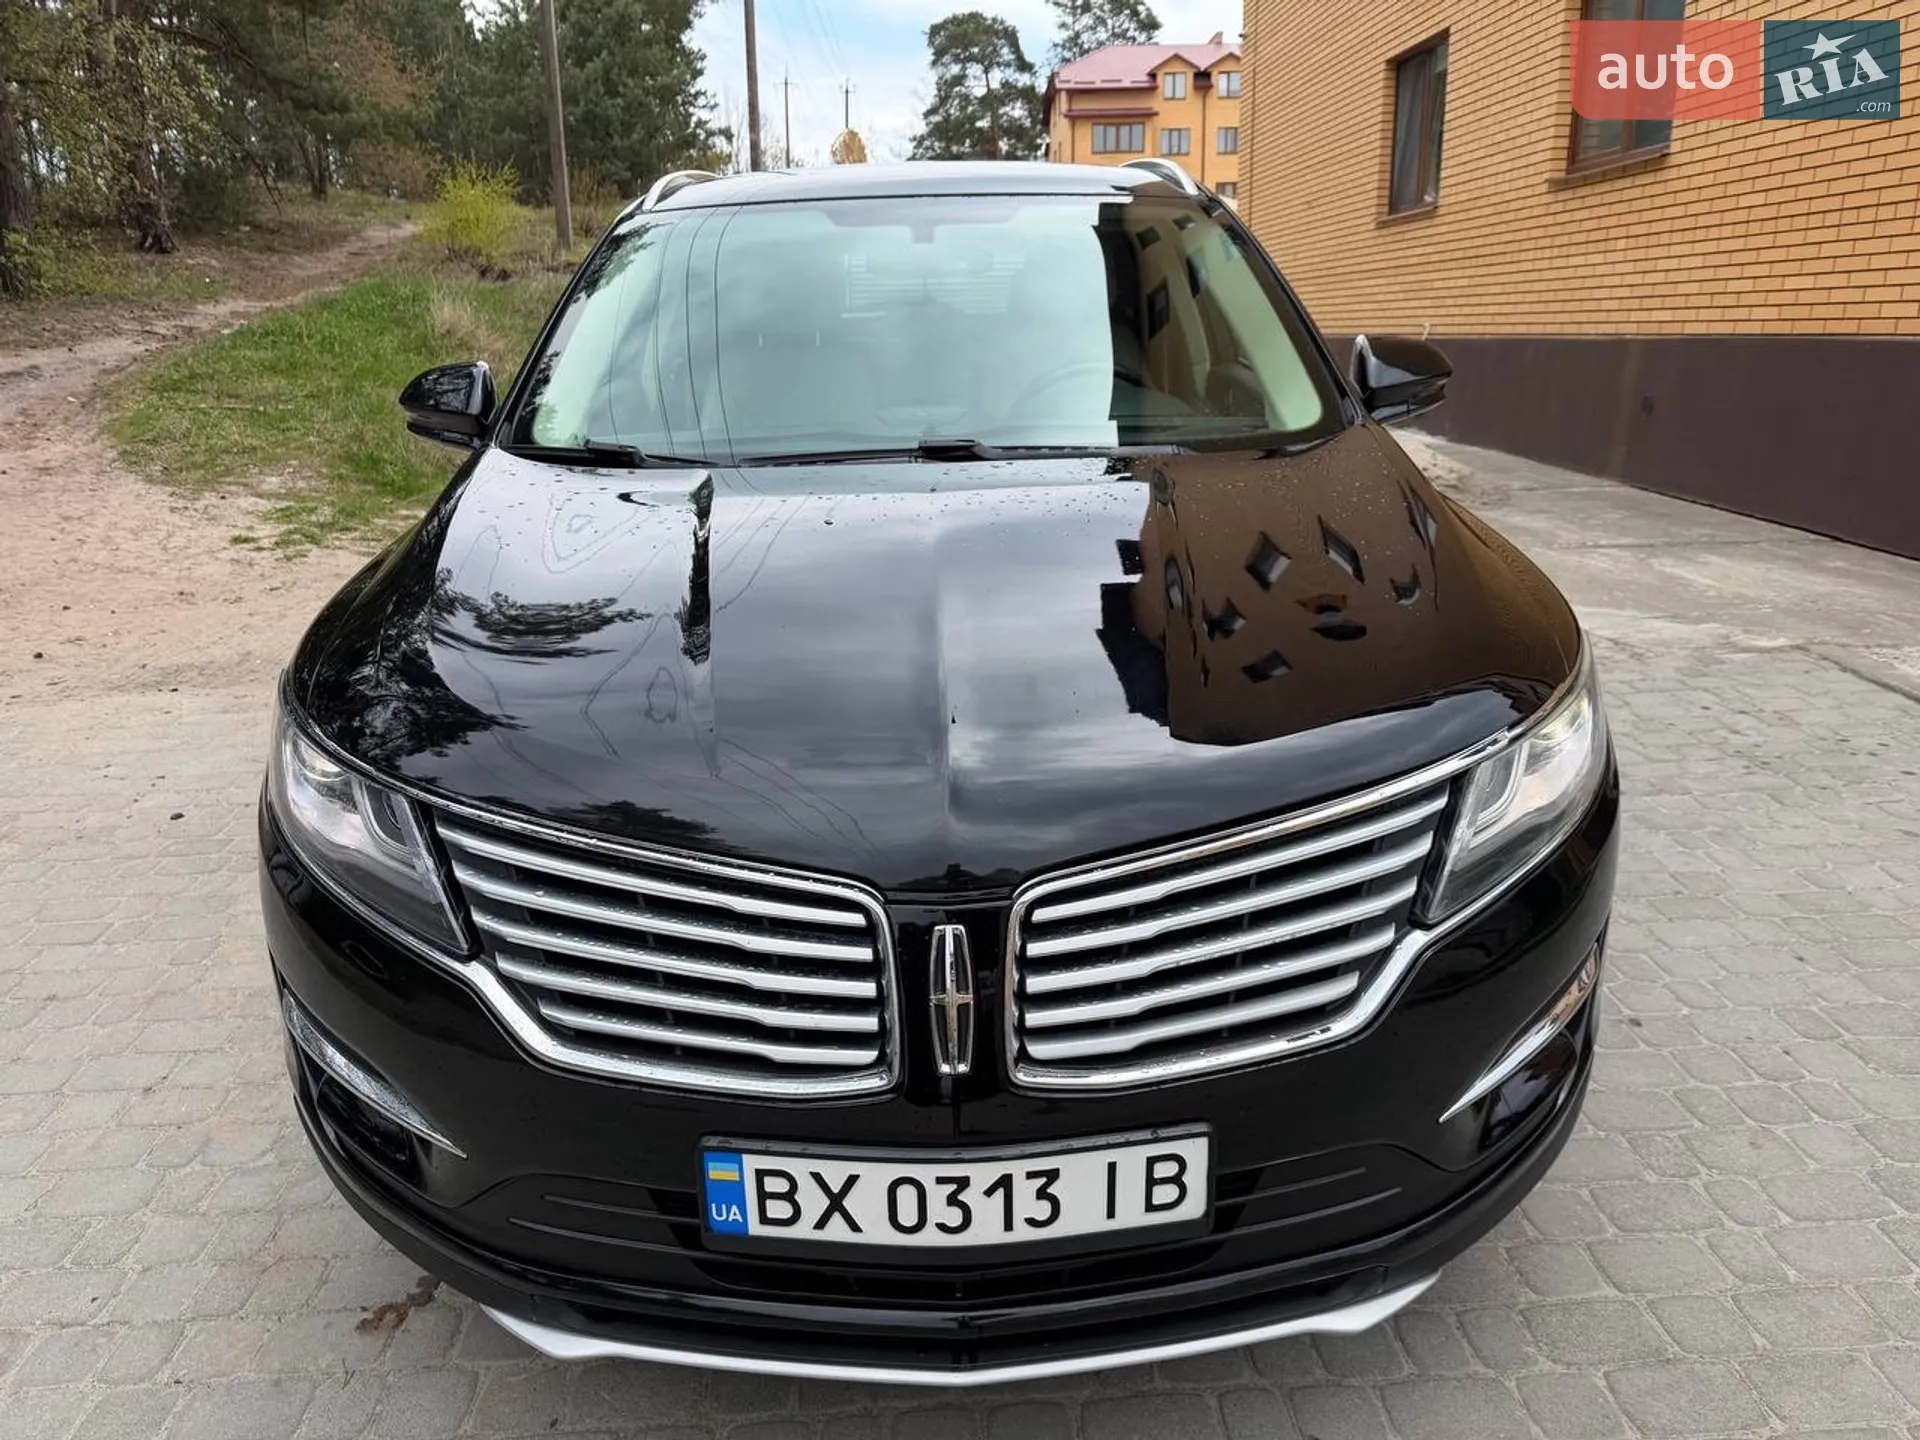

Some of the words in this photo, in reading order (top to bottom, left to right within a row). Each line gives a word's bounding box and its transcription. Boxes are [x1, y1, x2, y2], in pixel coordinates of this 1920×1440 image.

[711, 1204, 743, 1223] UA
[754, 1168, 864, 1233] BX
[887, 1168, 1062, 1235] 0313
[1105, 1152, 1188, 1220] IB
